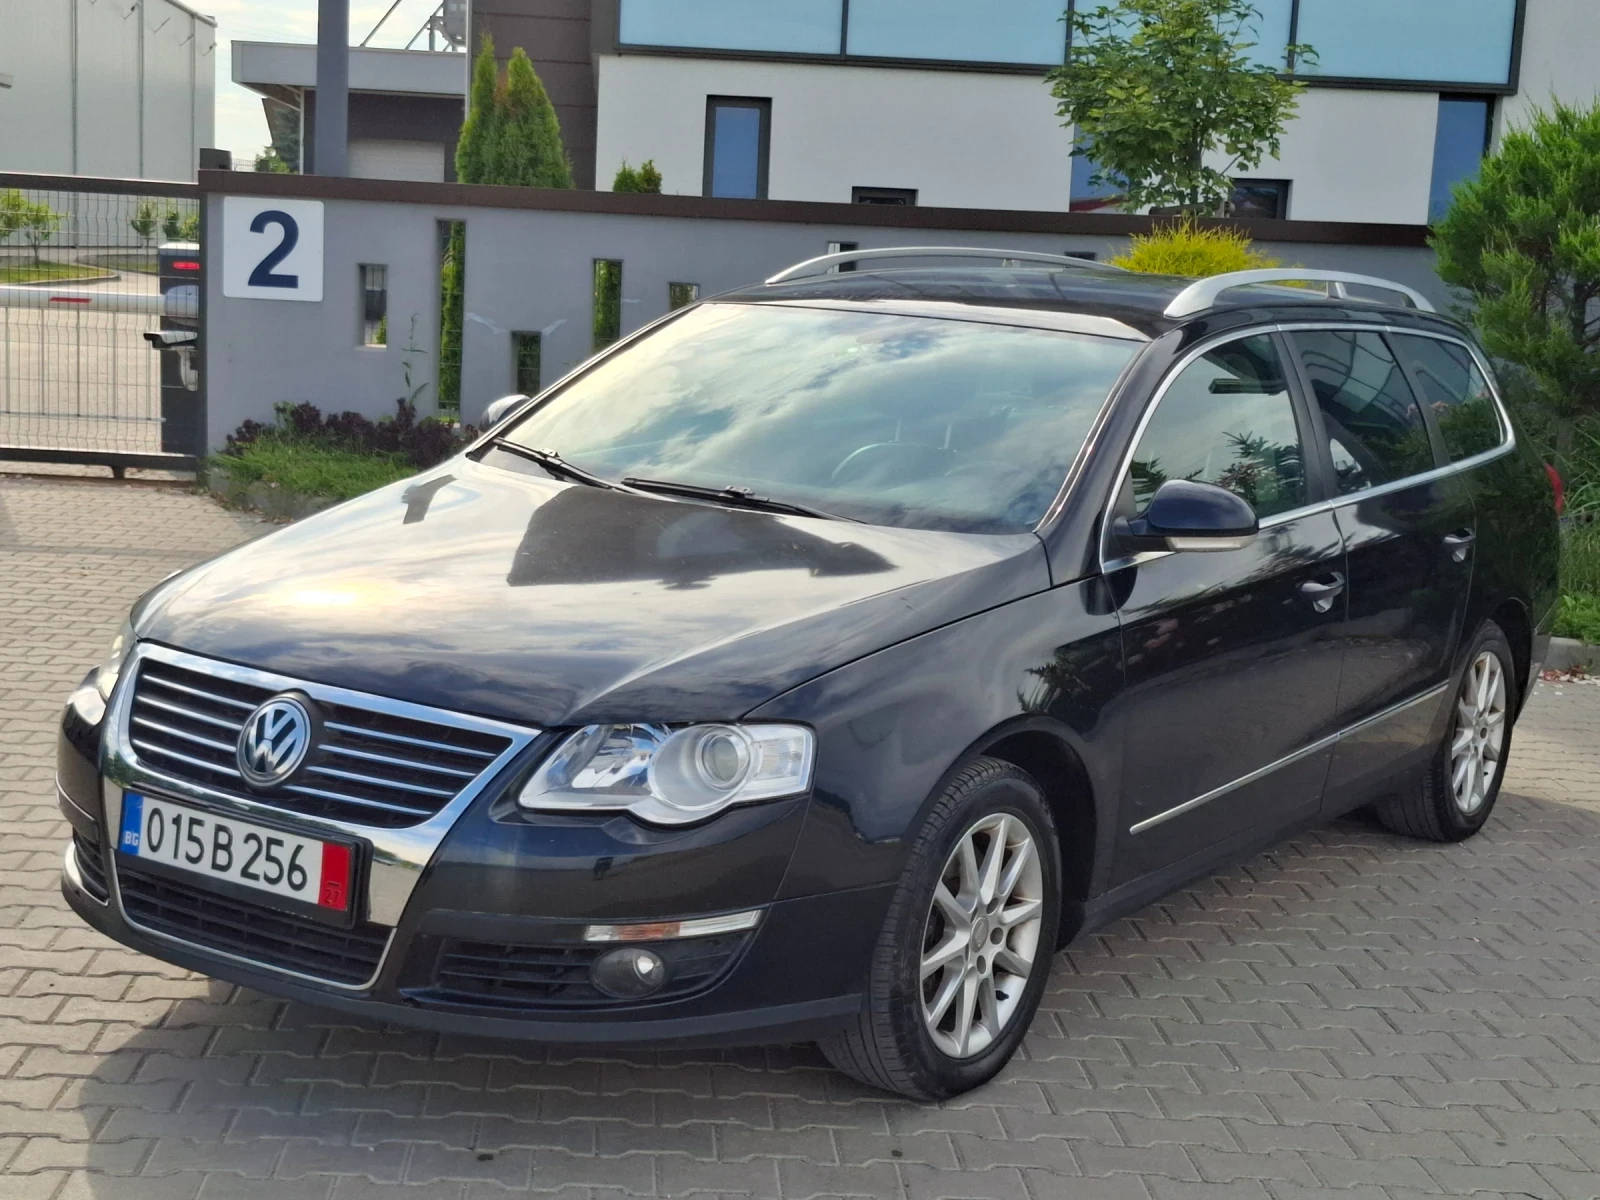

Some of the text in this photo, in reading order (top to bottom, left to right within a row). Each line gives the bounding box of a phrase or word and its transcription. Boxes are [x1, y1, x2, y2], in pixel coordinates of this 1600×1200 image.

[247, 209, 300, 290] 2
[242, 699, 307, 779] VW
[124, 830, 140, 847] BG
[146, 807, 308, 892] 015B256
